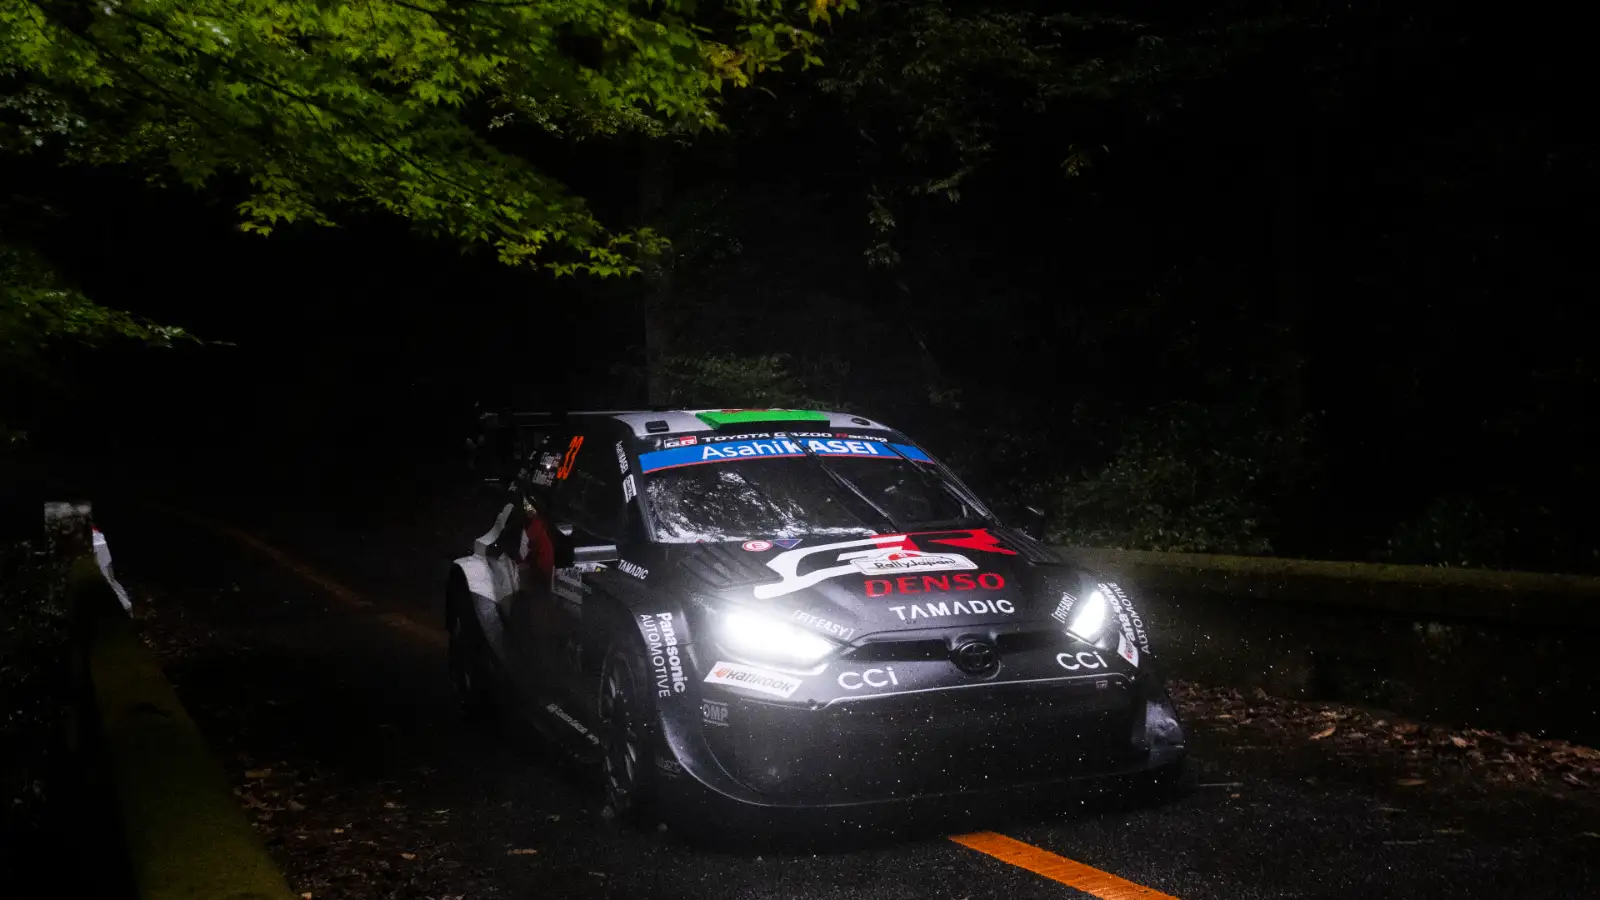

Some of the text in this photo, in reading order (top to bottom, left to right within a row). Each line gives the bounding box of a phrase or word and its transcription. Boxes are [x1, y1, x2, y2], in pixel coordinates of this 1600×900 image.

[701, 432, 770, 442] TOYOTA
[701, 439, 879, 460] AsahiKASEI
[617, 558, 649, 580] TAMADIC
[864, 572, 1006, 598] DENSO
[888, 599, 1016, 621] TAMADIC
[1097, 582, 1137, 644] anasonic
[1106, 581, 1151, 655] AUTOMOTIVE
[639, 613, 671, 698] AUTOMOTIVE
[655, 611, 689, 693] Panasonic
[702, 703, 729, 721] OMP
